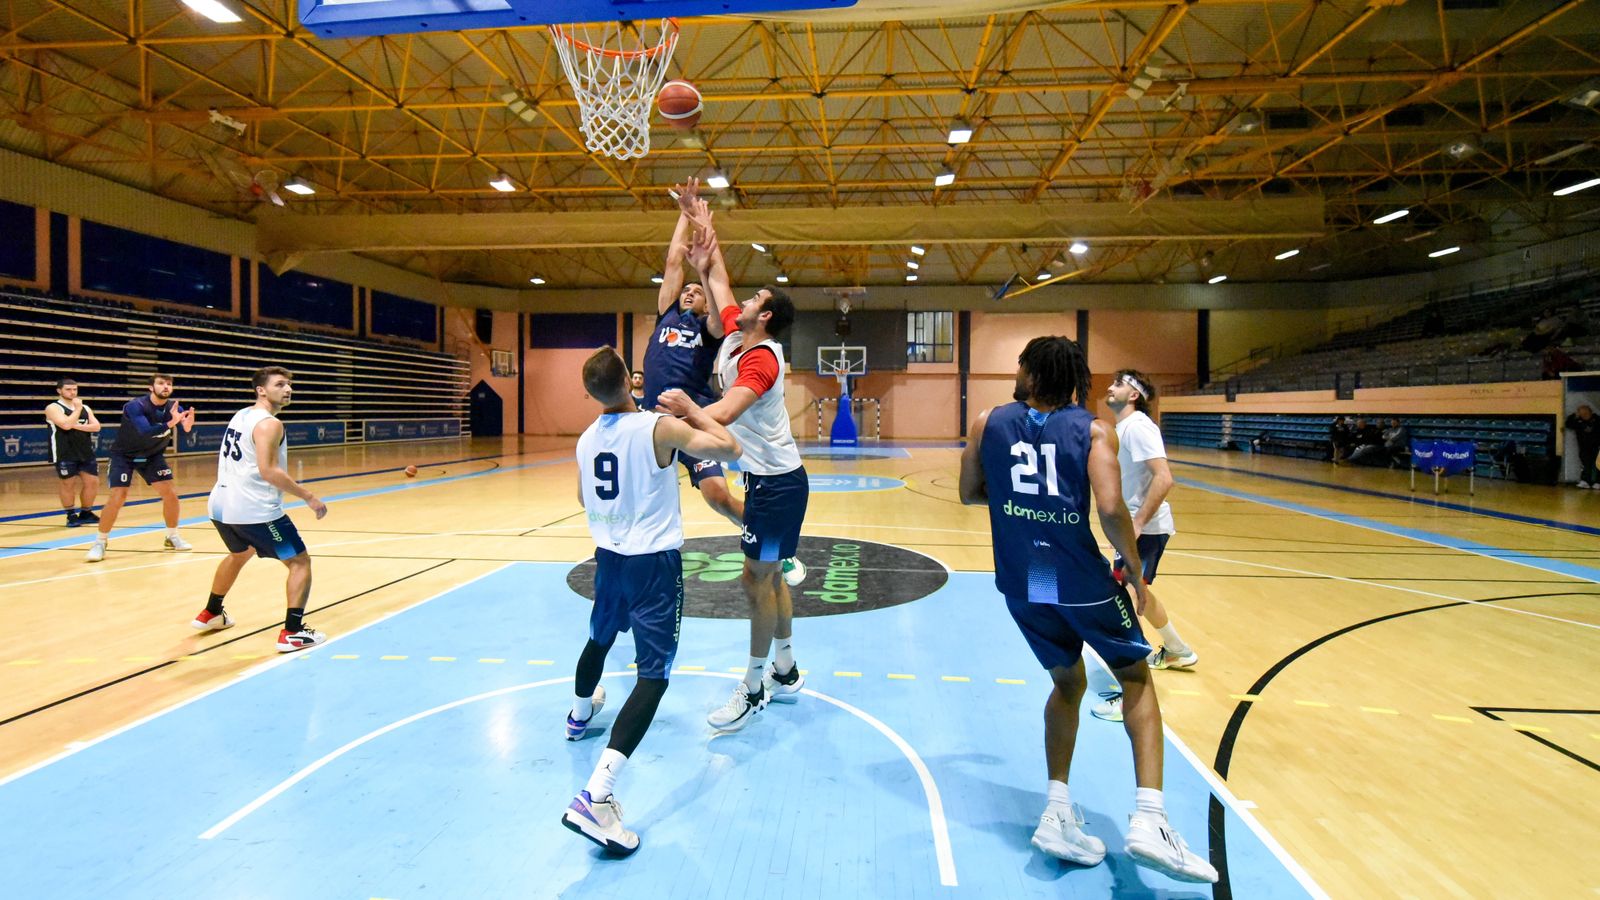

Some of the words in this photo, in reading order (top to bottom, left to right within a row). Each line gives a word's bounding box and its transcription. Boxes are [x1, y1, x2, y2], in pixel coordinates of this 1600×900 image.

[659, 327, 703, 348] UDEA
[120, 473, 128, 482] 0
[594, 452, 619, 500] 9
[1010, 440, 1059, 496] 21
[803, 543, 860, 603] damex.io
